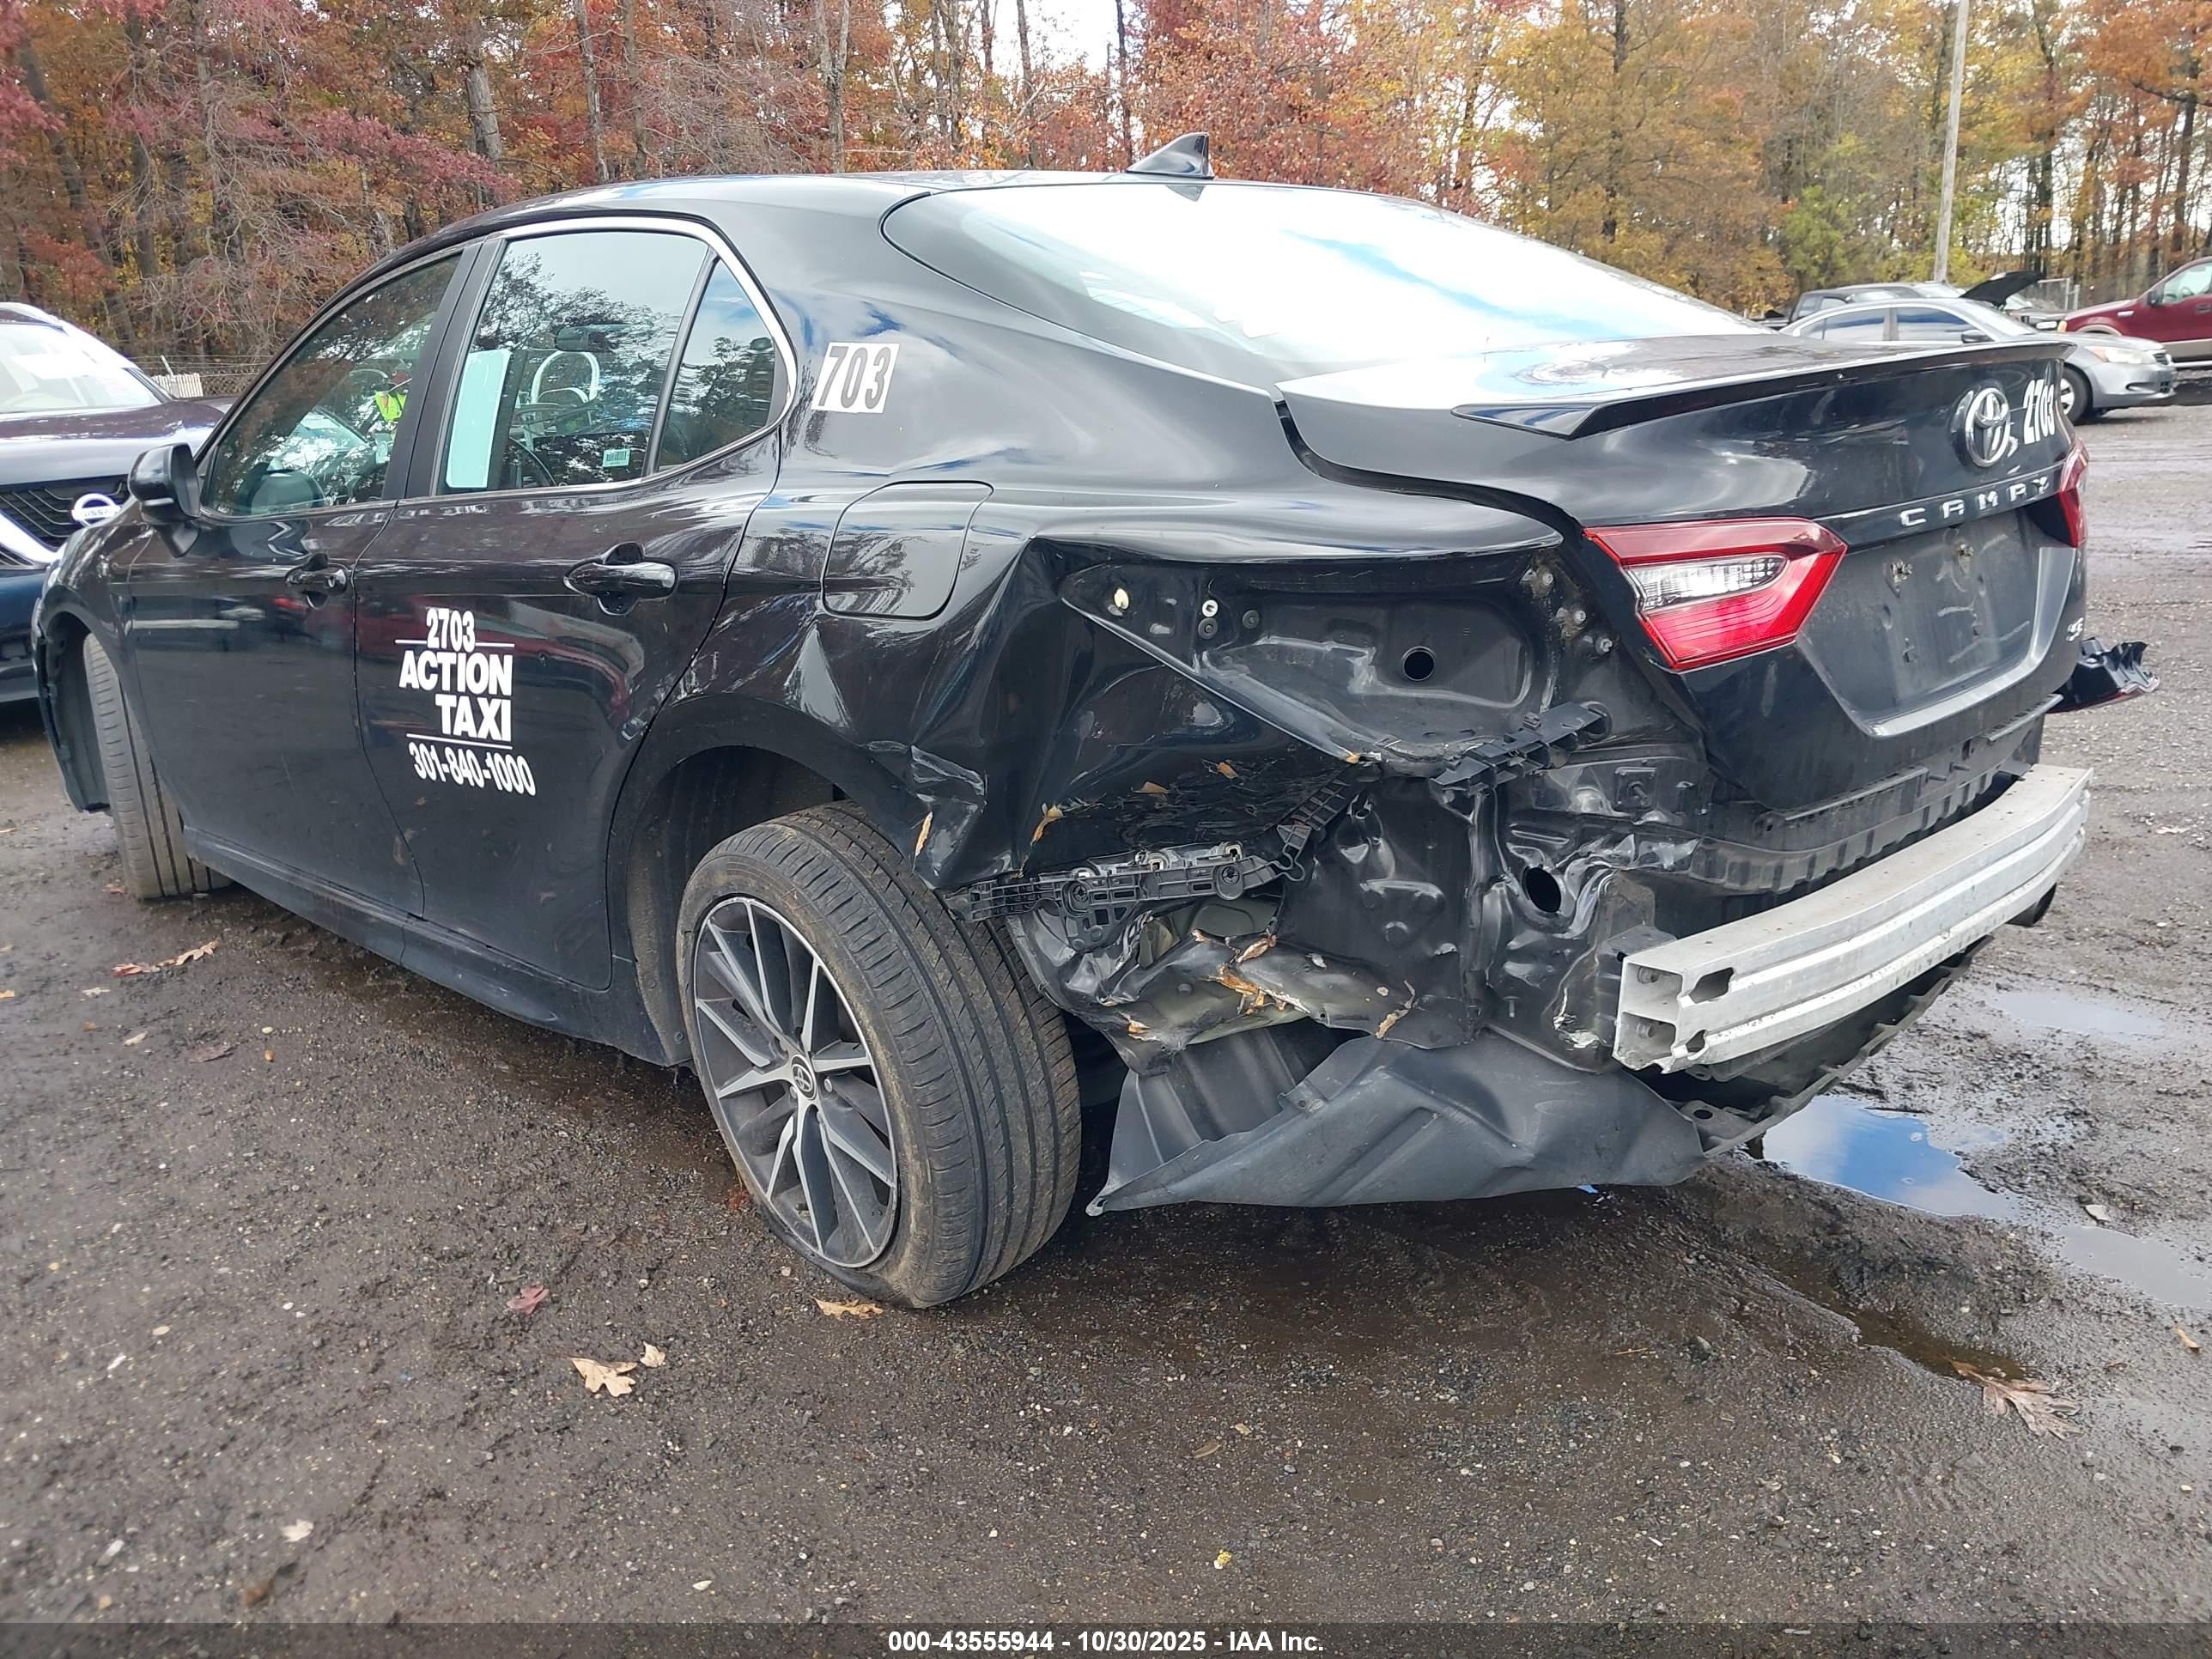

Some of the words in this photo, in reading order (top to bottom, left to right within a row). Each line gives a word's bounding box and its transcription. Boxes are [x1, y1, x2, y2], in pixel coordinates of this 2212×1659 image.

[818, 345, 891, 410] 703
[2023, 379, 2056, 445] 2703
[1899, 476, 2051, 526] CAMRY
[426, 608, 476, 653] 2703
[398, 650, 514, 696] ACTION
[434, 693, 512, 742] TAXI
[408, 741, 537, 796] 301-840-1000
